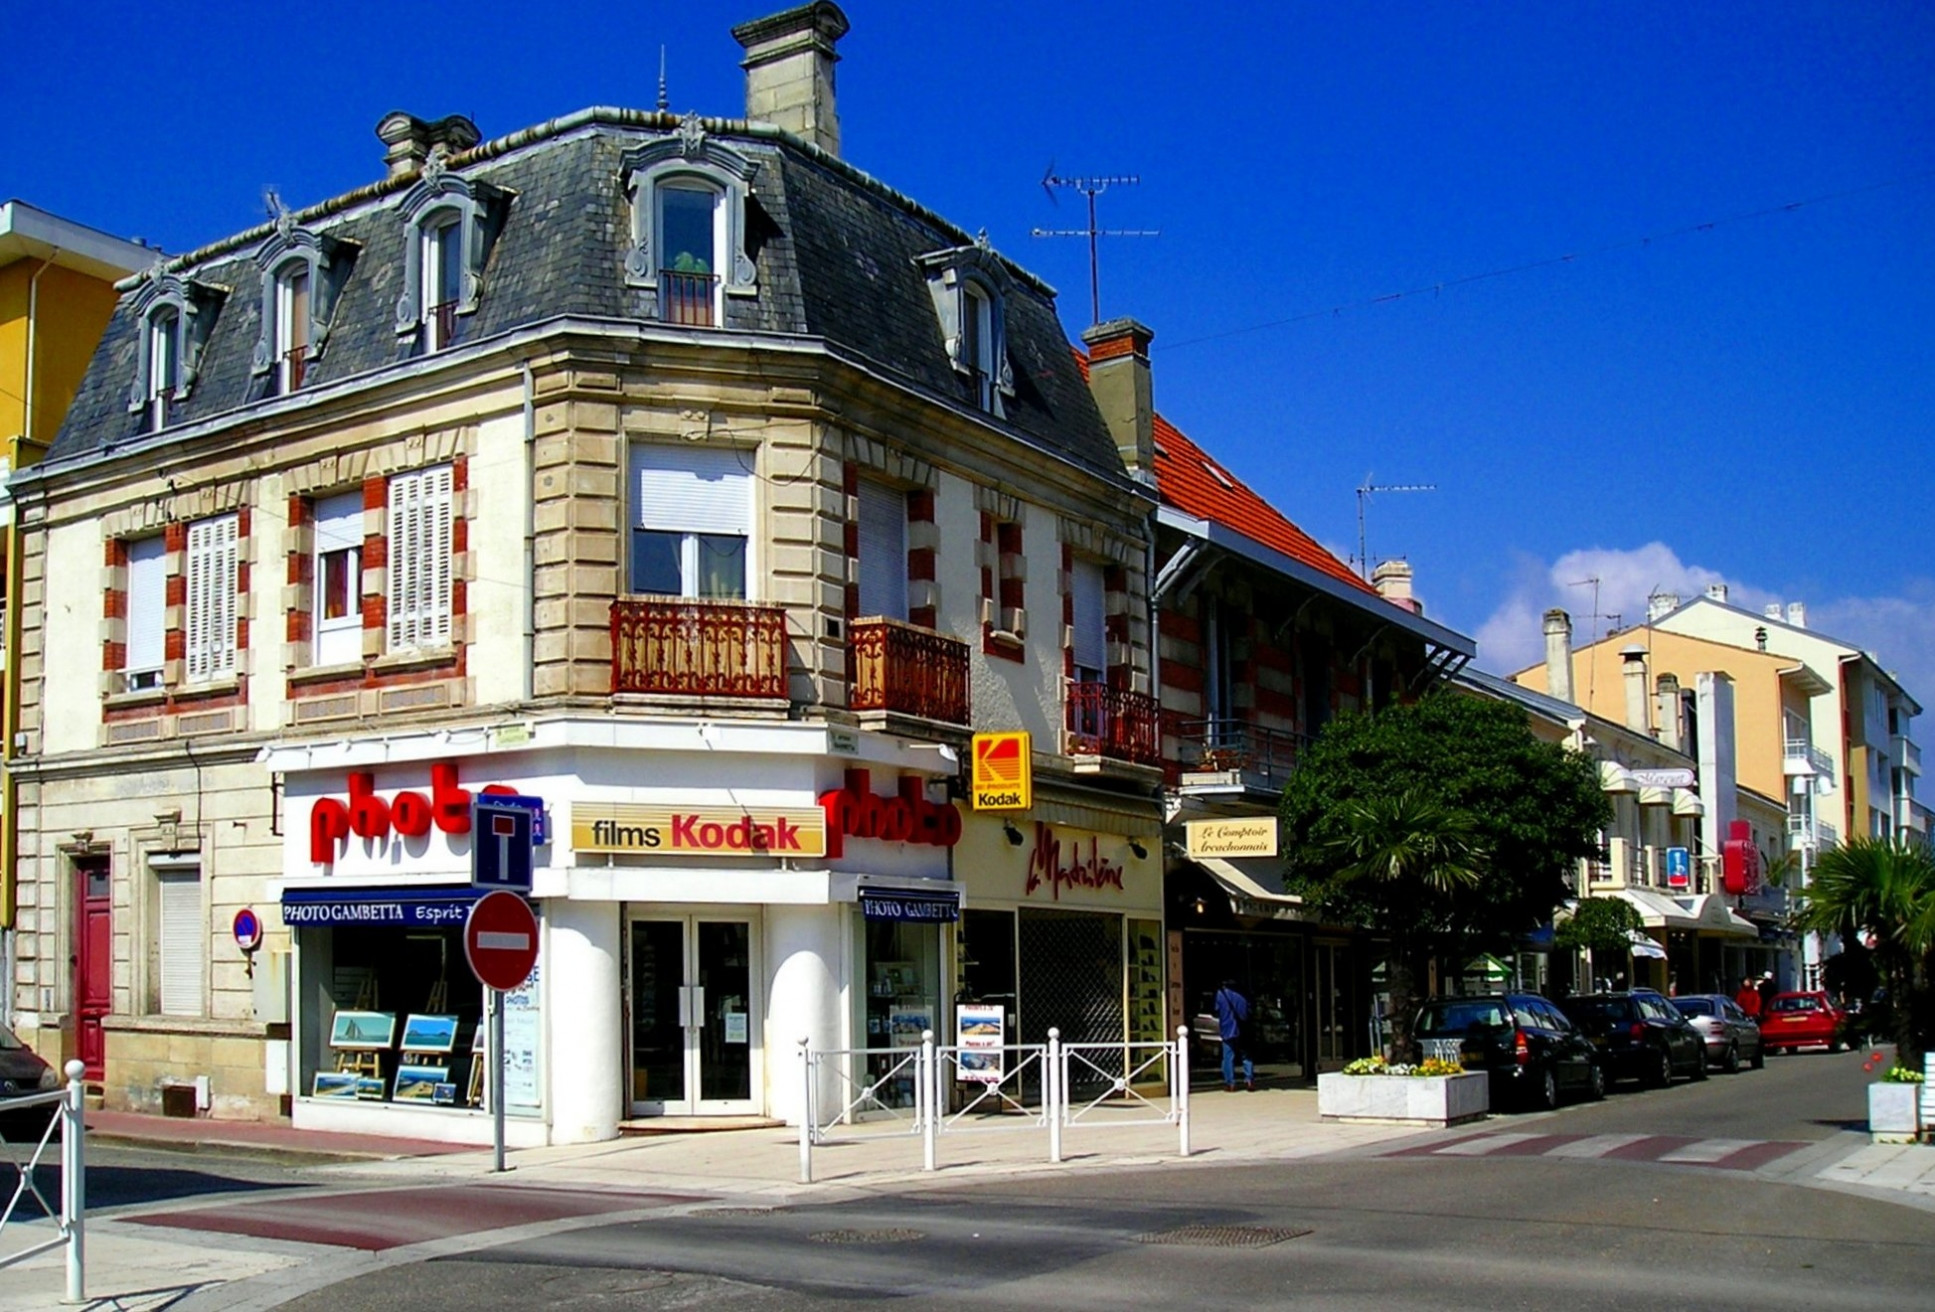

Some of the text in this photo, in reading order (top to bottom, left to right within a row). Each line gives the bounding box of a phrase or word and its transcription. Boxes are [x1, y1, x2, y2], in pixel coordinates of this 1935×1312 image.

[978, 792, 1021, 806] Kodak
[311, 763, 519, 863] phot
[818, 768, 962, 858] photo
[592, 814, 801, 850] films Kodak
[1217, 826, 1268, 839] Comptoir
[284, 904, 331, 921] PHOTO
[333, 904, 404, 920] GAMBETTA
[415, 904, 463, 924] Esprit
[865, 900, 901, 916] PHOTO
